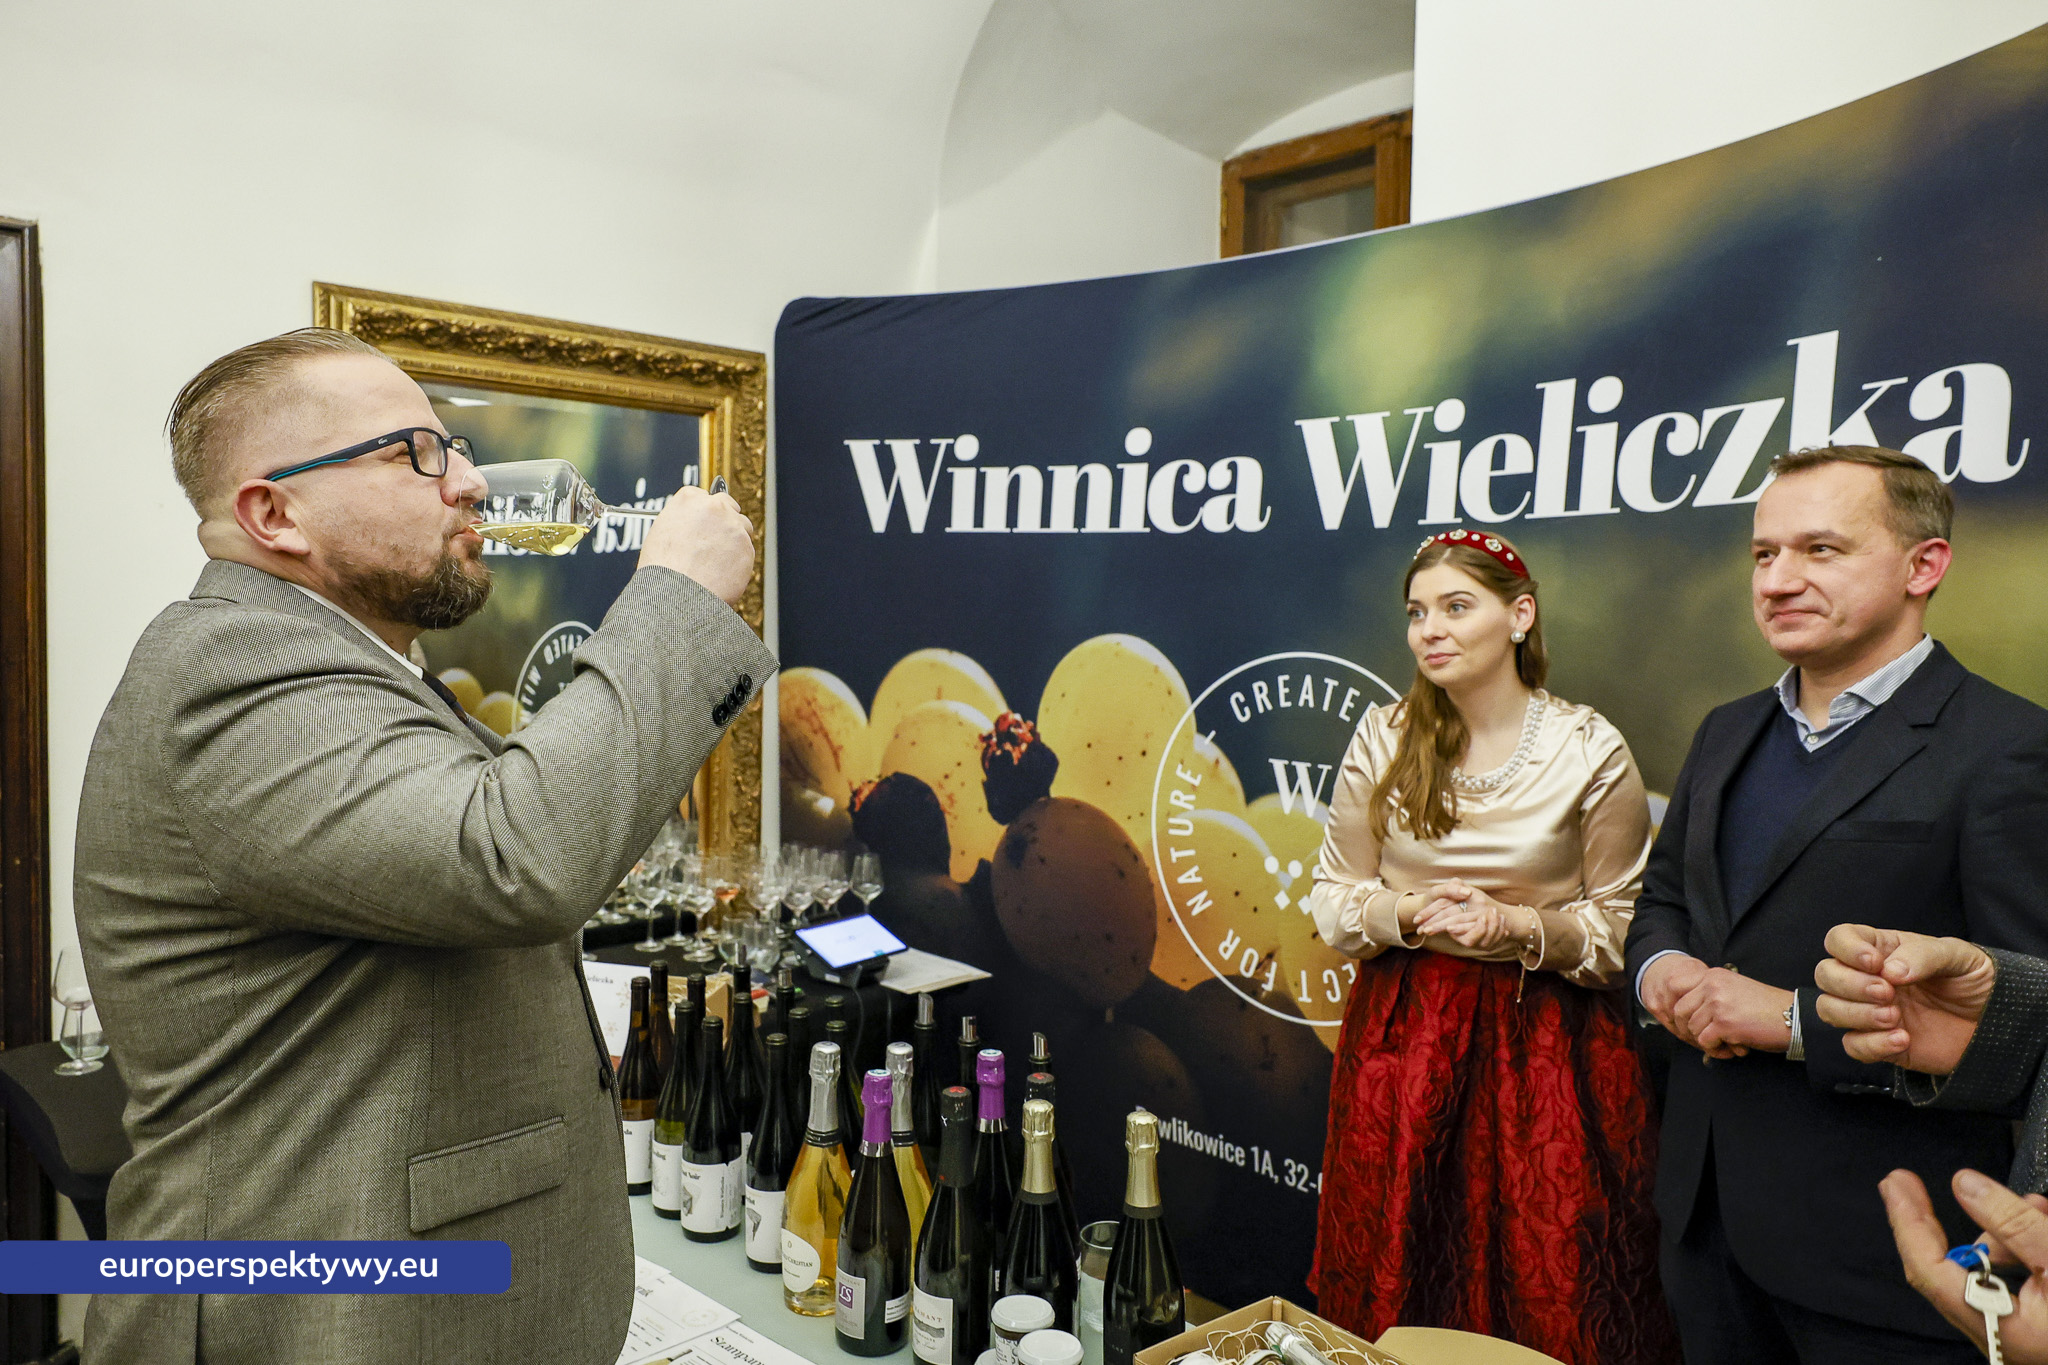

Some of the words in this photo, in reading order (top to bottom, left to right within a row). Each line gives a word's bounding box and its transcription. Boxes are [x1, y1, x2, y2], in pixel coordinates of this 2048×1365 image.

[843, 427, 1272, 534] Winnica
[1295, 329, 2030, 530] Wieliczka
[1268, 758, 1332, 818] W
[1168, 763, 1213, 916] NATURE
[1218, 929, 1277, 991] FOR
[1134, 1105, 1246, 1167] wlikowice
[1251, 1146, 1279, 1184] 1A,
